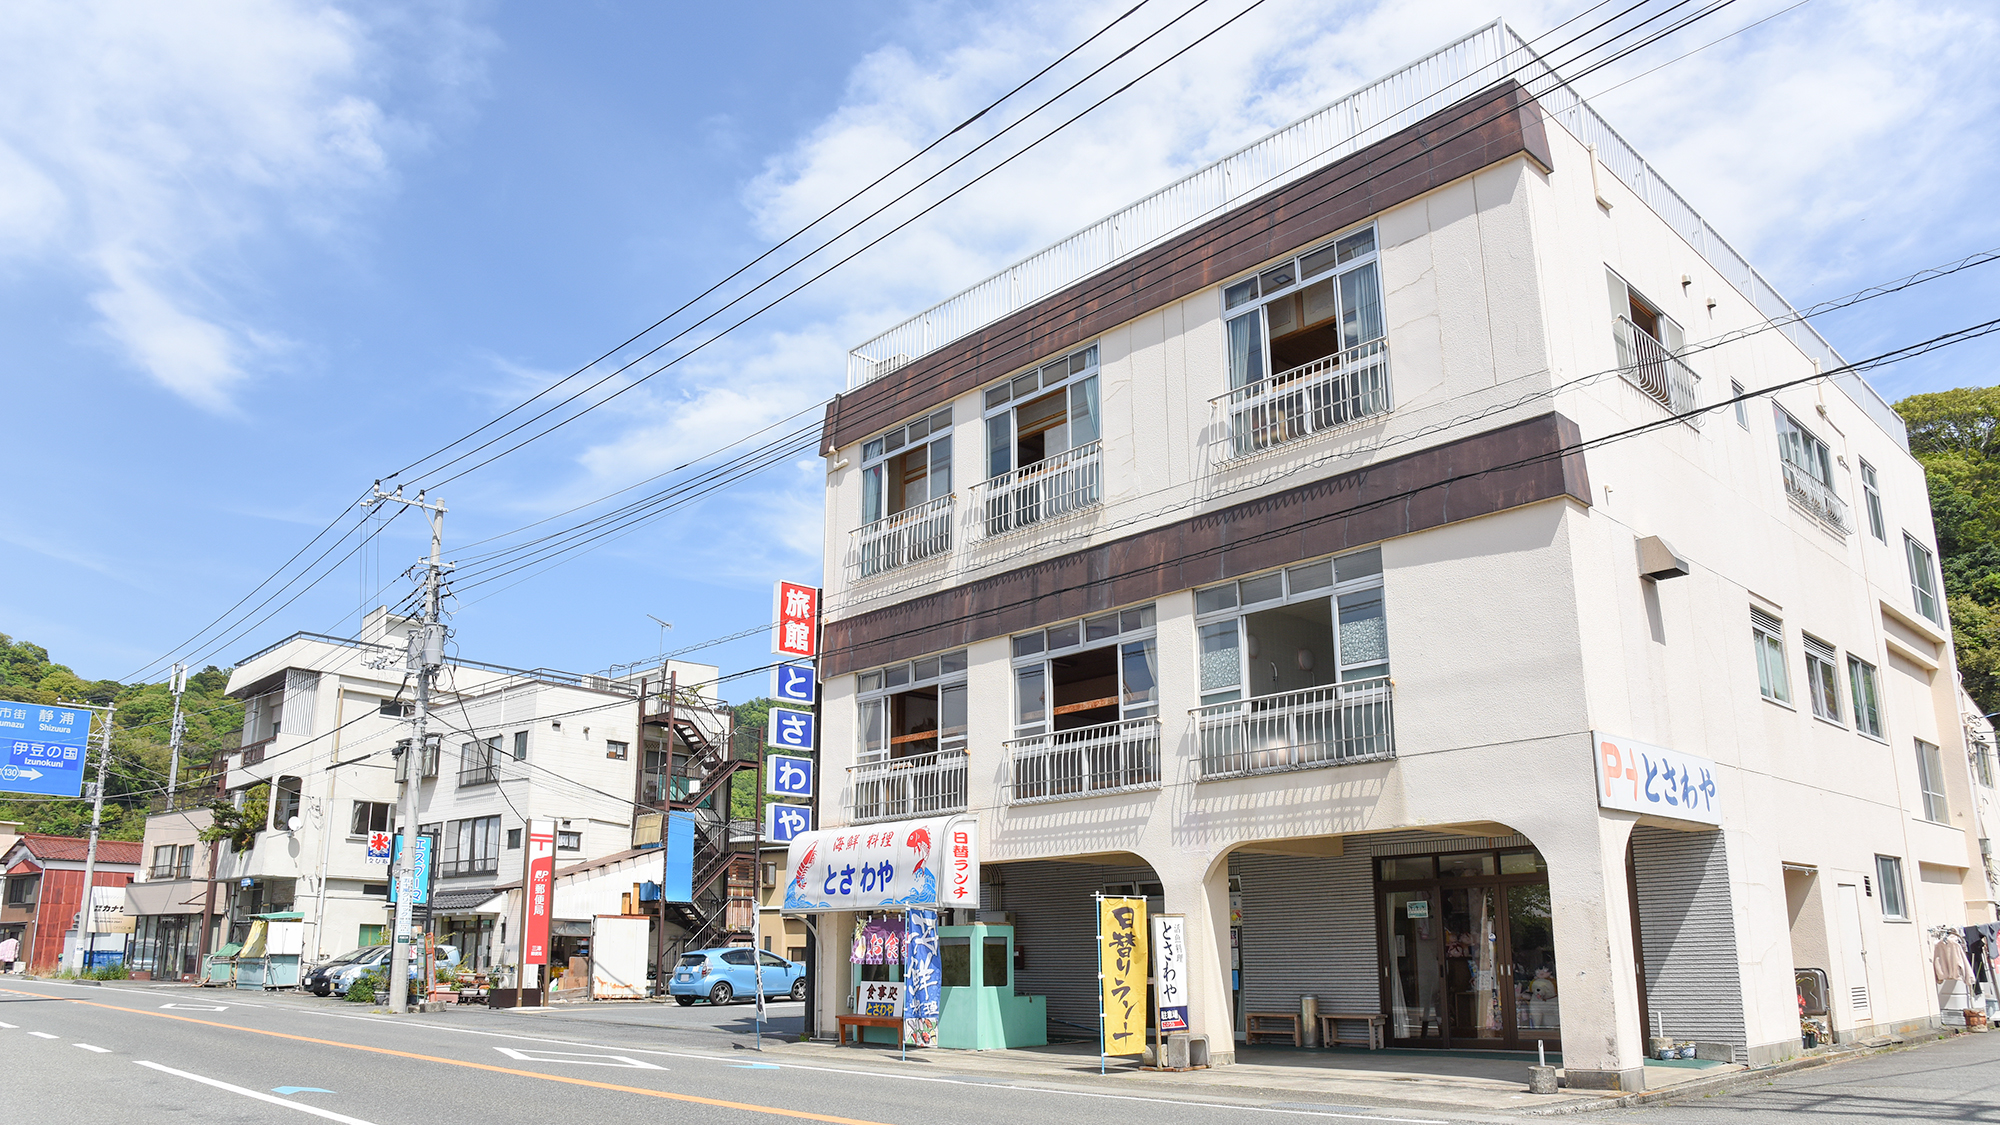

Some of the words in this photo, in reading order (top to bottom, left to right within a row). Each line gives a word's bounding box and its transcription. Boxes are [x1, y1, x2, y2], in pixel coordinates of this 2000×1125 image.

[784, 588, 811, 652] 旅館
[0, 707, 26, 720] 市街
[38, 709, 75, 725] 静浦
[39, 723, 71, 734] Shizuura
[13, 741, 78, 761] 伊豆の国
[778, 668, 807, 839] とさわや
[4, 768, 17, 777] 130
[24, 757, 64, 768] Izunokuni
[1641, 753, 1716, 812] とさわや
[371, 833, 389, 851] 氷
[833, 834, 860, 852] 海鮮
[866, 831, 895, 848] 料理
[953, 831, 969, 899] 日替ランチ
[824, 859, 894, 895] とさわや
[533, 884, 546, 916] 郵便局
[1162, 921, 1177, 1003] とさわや
[1108, 906, 1138, 1048] 日替りランチ
[866, 984, 898, 1001] 食事処
[866, 1003, 894, 1016] とさわや
[909, 998, 939, 1015] 料理
